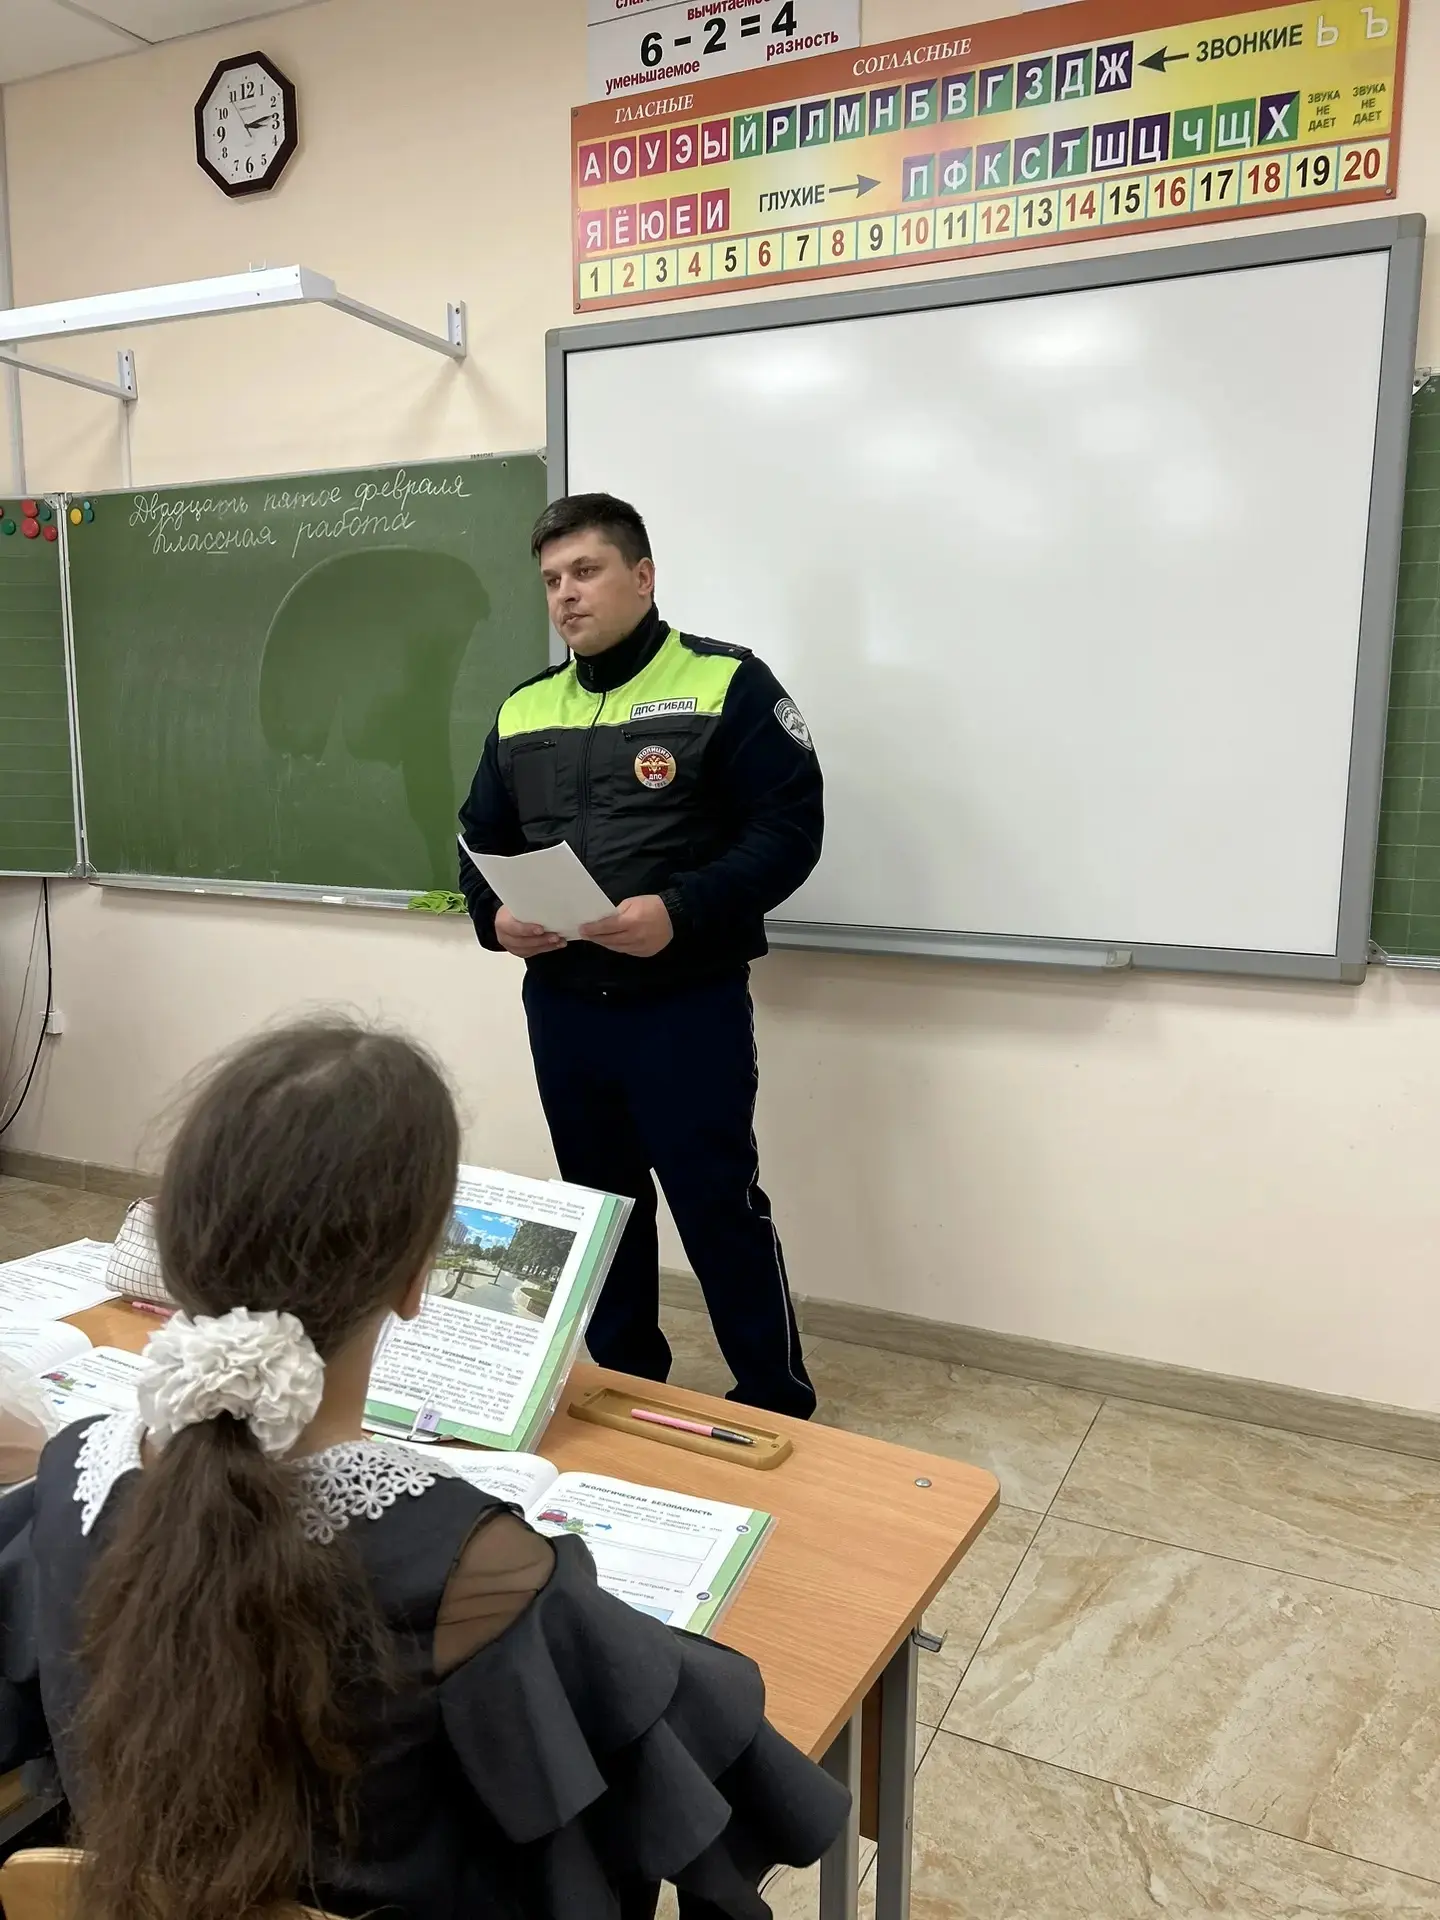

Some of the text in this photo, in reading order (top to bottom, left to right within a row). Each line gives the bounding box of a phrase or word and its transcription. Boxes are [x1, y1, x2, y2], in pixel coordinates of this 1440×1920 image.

[640, 32, 663, 67] 6
[702, 18, 727, 54] 2
[771, 0, 797, 37] 4
[1316, 6, 1389, 47] Ь Ъ
[766, 30, 839, 60] разность
[1196, 24, 1303, 62] ЗВОНКИЕ
[853, 38, 972, 76] СОГЛАСНЫЕ
[606, 60, 700, 95] уменьшаемое
[229, 90, 236, 103] 11
[240, 81, 254, 100] 12
[260, 84, 264, 96] 1
[1307, 90, 1340, 104] ЗВУКА
[1352, 83, 1386, 97] ЗВУКА
[271, 96, 276, 108] 2
[615, 94, 693, 124] ГЛАСНЫЕ
[1316, 105, 1330, 115] НЕ
[1361, 98, 1375, 109] НЕ
[218, 108, 228, 120] 10
[272, 112, 280, 129] 3
[584, 50, 1129, 181] А О У Э Ы Й Р Л М Н Б В Г З Д Ж
[1353, 110, 1382, 125] ДАЕТ
[1308, 117, 1336, 132] ДАЕТ
[217, 126, 226, 143] 9
[272, 135, 277, 146] 4
[222, 147, 228, 158] 8
[910, 104, 1290, 197] П Ф К С Т Ш Ц Ч Щ Х
[234, 160, 239, 171] 7
[246, 156, 254, 173] 6
[261, 154, 267, 166] 5
[759, 184, 825, 213] ГЛУХИЕ
[586, 200, 723, 248] Я Ё Ю Е И
[590, 148, 1380, 292] 1 2 3 4 5 6 7 8 9 10 11 12 13 14 15 16 17 18 19 20
[264, 487, 342, 511] пятое
[355, 469, 472, 511] февраля
[148, 507, 416, 558] Классная работа
[634, 701, 692, 716] ДПС ГИБДД
[638, 747, 670, 760] ПОЛИЦИЯ
